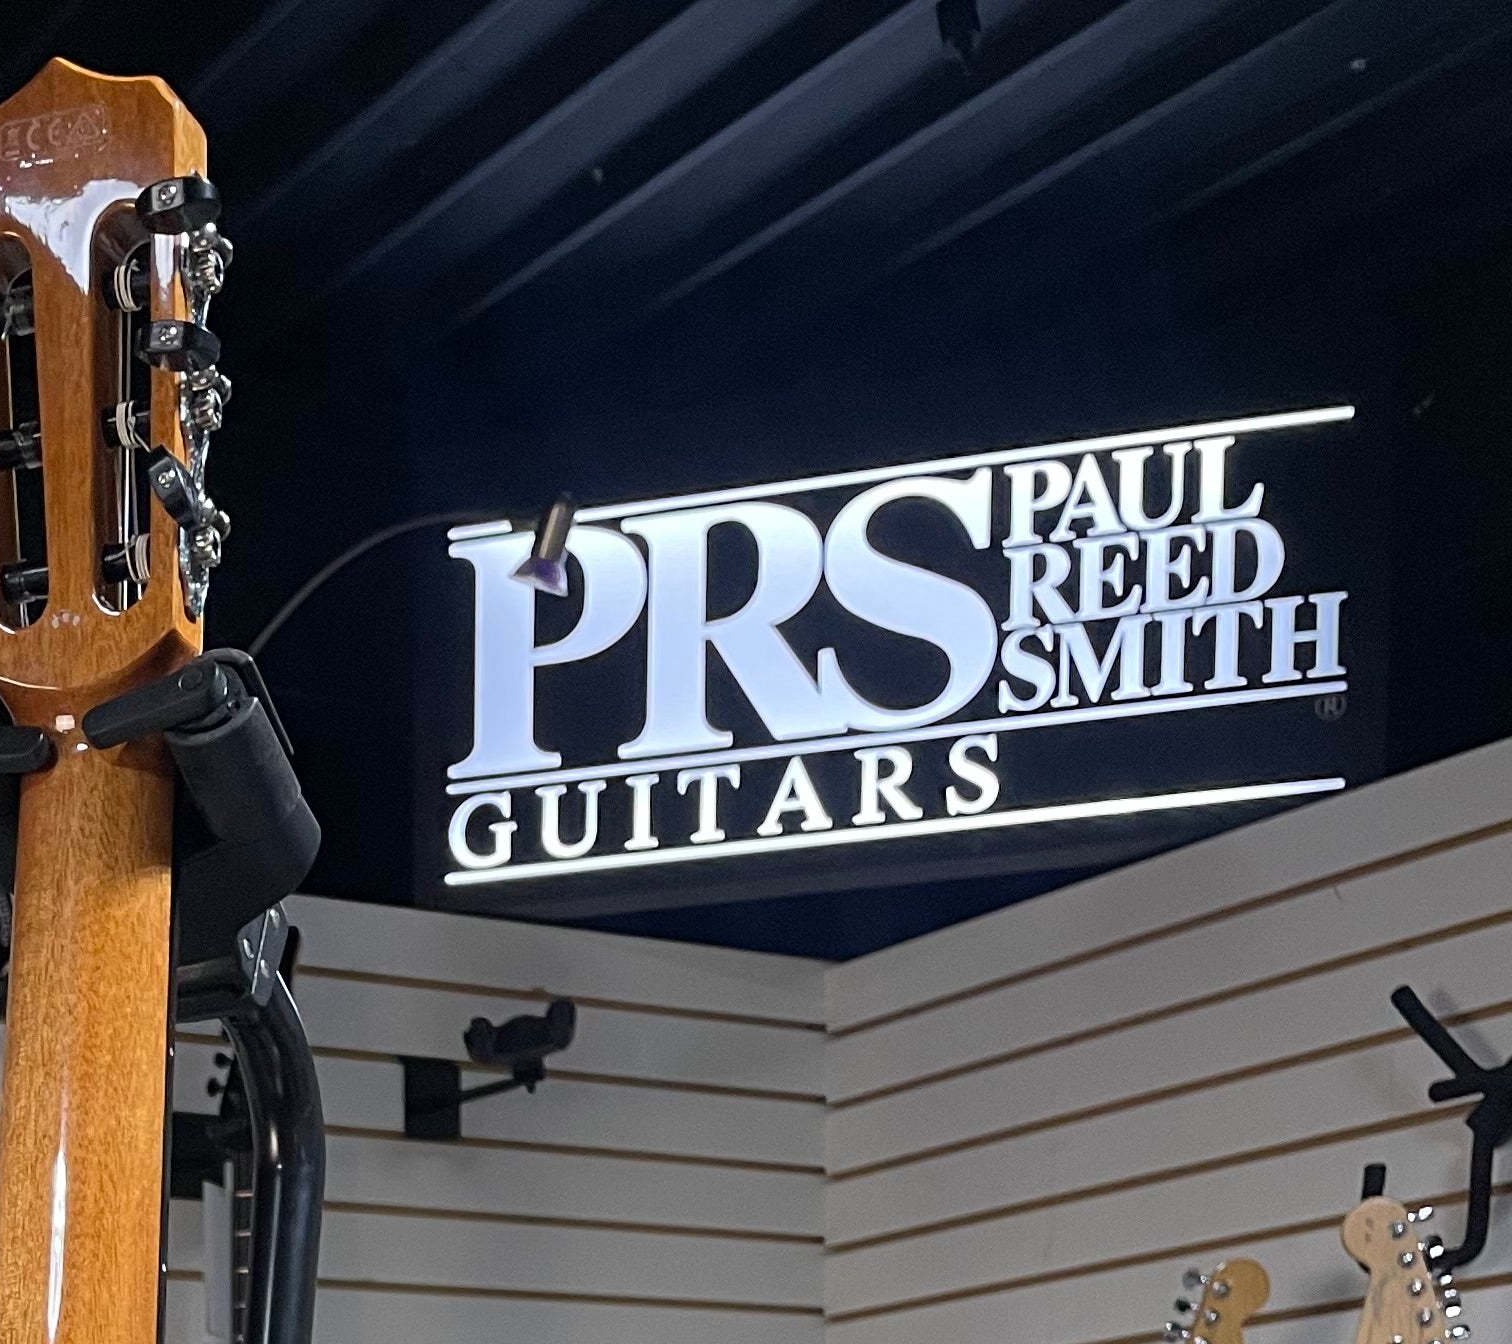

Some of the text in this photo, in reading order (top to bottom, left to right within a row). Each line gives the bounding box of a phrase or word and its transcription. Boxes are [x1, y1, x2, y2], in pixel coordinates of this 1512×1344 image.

[1003, 436, 1264, 547] PAUL
[449, 467, 999, 779] PRS
[1003, 519, 1286, 632] REED
[998, 591, 1348, 715] SMITH
[449, 735, 1000, 870] GUITARS
